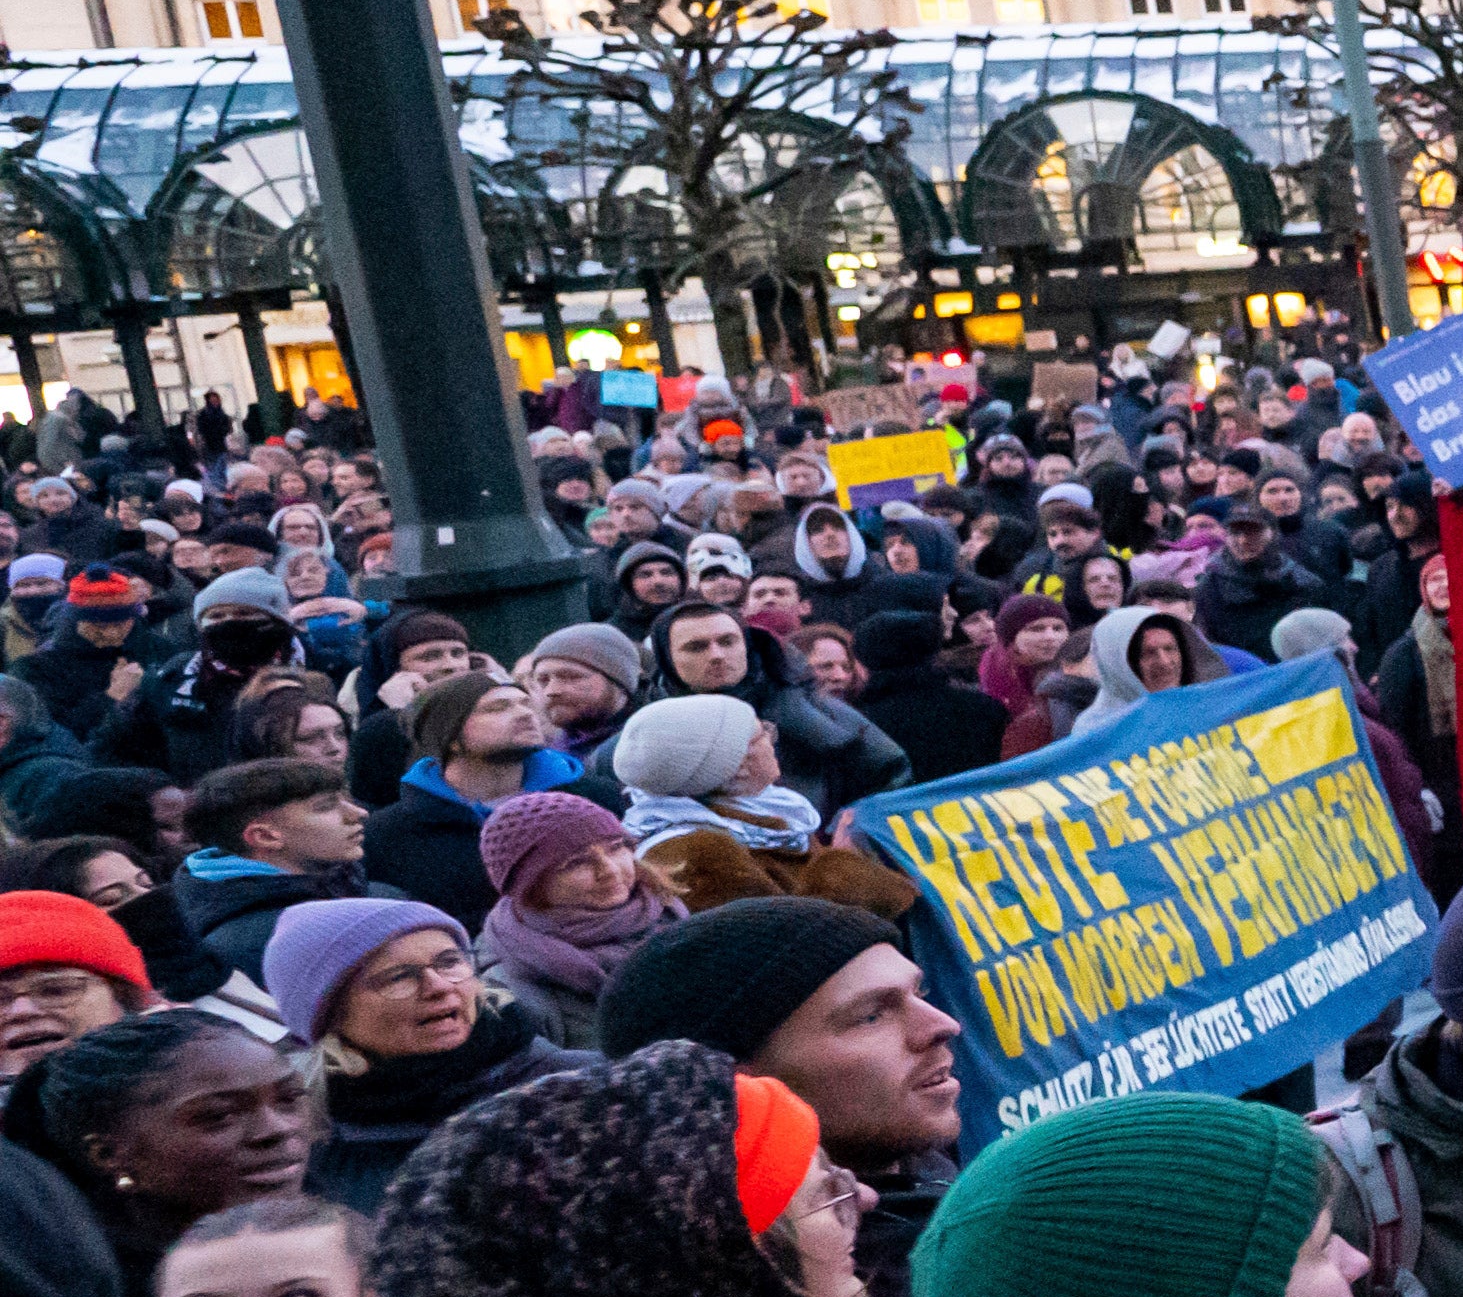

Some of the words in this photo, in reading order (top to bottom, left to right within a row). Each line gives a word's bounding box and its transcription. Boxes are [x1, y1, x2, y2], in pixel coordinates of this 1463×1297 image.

[1393, 367, 1452, 406] Blau
[1416, 401, 1461, 434] das
[886, 780, 1131, 964] HEUTE
[975, 944, 1078, 1059] VON
[1053, 898, 1205, 1024] MORGEN
[1150, 761, 1408, 967] VERHINDERN
[997, 1059, 1093, 1138] SCHUTZ
[1098, 1040, 1144, 1097] FÜR
[1130, 996, 1252, 1085] GEFLÜCHTETE
[1243, 971, 1297, 1034] STATT
